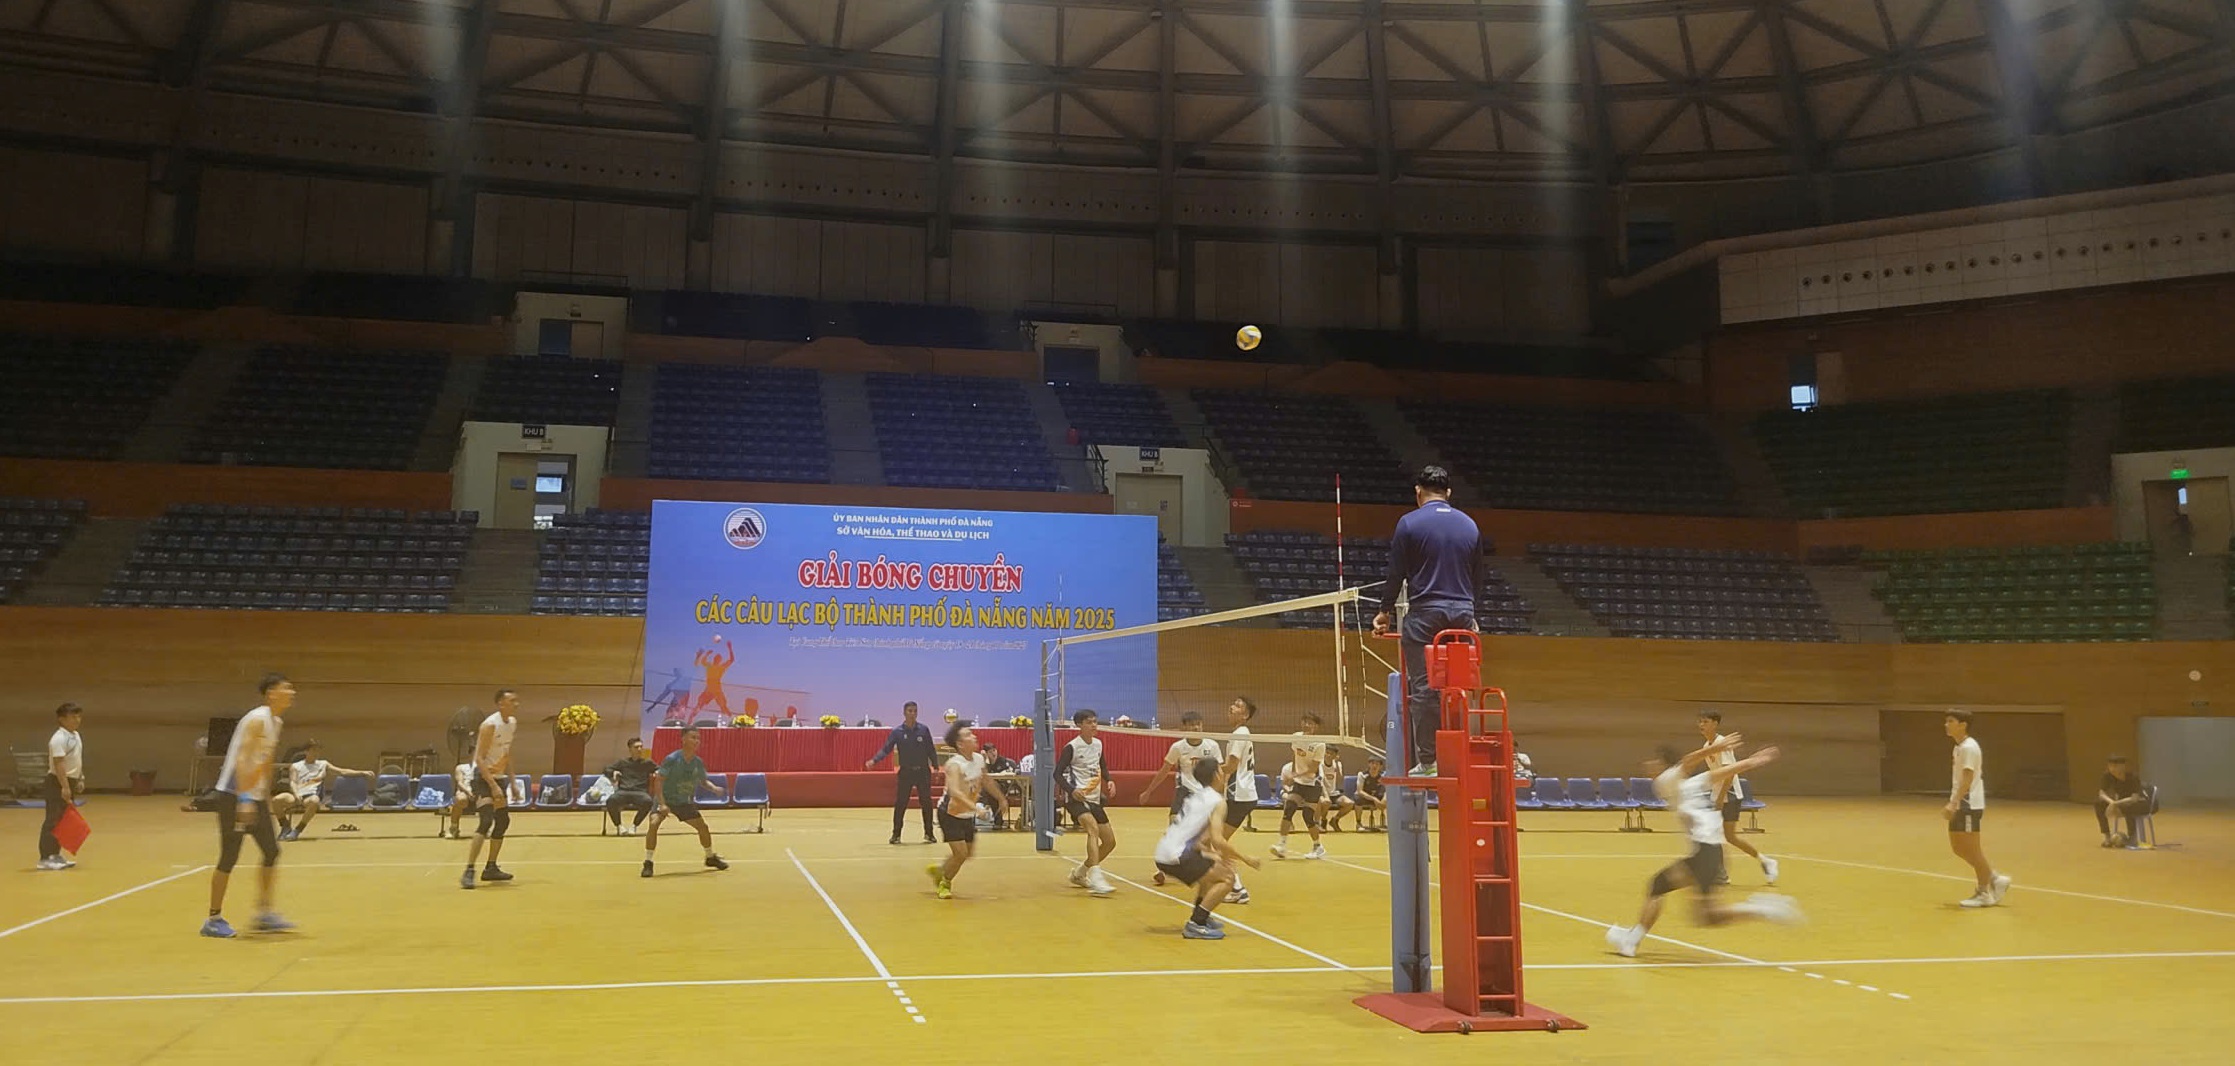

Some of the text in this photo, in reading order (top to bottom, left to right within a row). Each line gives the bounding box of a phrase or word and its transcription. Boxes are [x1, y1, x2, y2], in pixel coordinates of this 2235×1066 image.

[833, 513, 846, 522] ỦY
[846, 514, 864, 523] BAN
[865, 514, 889, 524] NHÂN
[891, 515, 909, 524] DÂN
[910, 516, 938, 526] THÀNH
[940, 516, 956, 526] PHỐ
[958, 518, 969, 526] ĐÀ
[872, 526, 894, 537] HÓA,
[915, 530, 940, 538] THAO
[941, 528, 953, 538] VÀ
[954, 531, 968, 539] DU
[969, 532, 989, 541] LỊCH
[798, 550, 1023, 593] GIẢI BÓNG CHUYỀN
[695, 595, 1115, 632] CÁC CÂU LẠC BỘ THÀNH PHỐ ĐÀ NẴNG NĂM 2025
